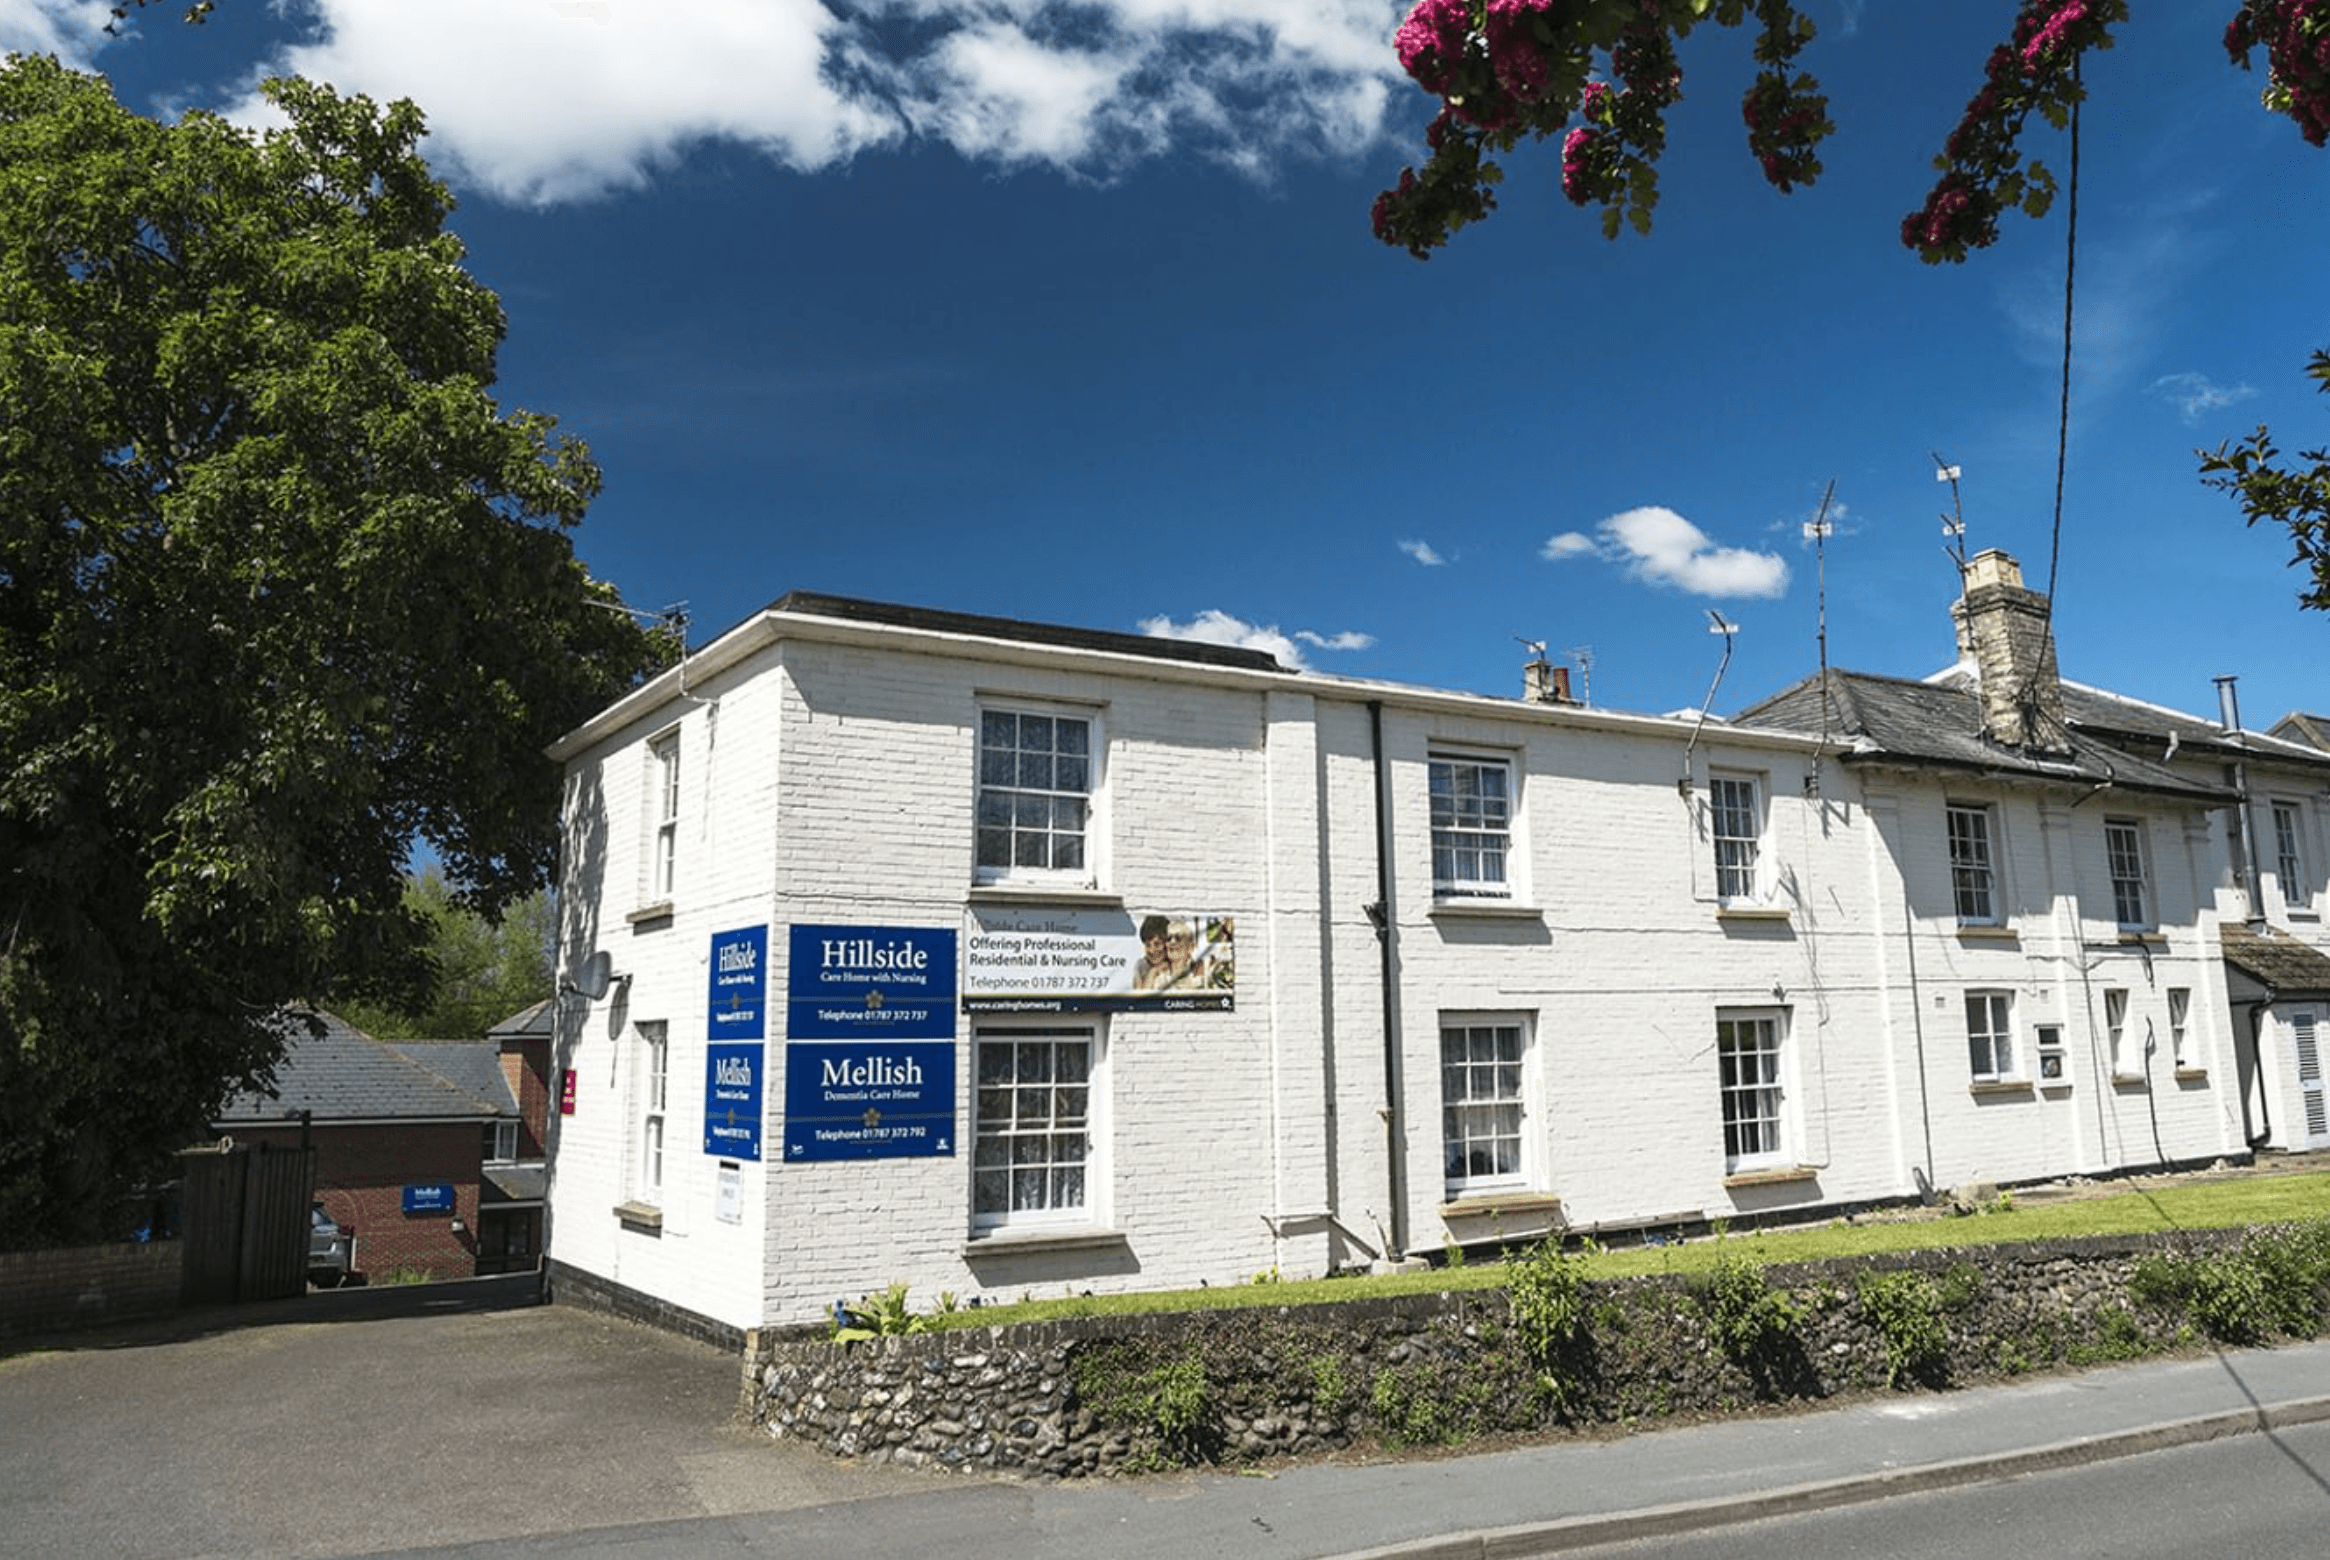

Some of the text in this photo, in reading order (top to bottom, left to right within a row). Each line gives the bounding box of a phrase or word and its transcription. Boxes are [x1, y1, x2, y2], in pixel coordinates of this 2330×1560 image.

[969, 937, 1096, 953] Offering Professional
[718, 940, 757, 973] Hillside
[821, 939, 928, 969] Hillside
[969, 953, 1126, 970] Residential & Nursing Care
[820, 970, 927, 986] Care Home with Nursing
[970, 976, 1109, 990] Telephone 01787 372 737
[818, 1009, 928, 1022] Telephone 01787 372 737
[715, 1057, 752, 1086] Mellish
[820, 1056, 924, 1087] Mellish
[824, 1089, 920, 1101] Dementia Care Home
[815, 1126, 926, 1141] Telephone 01787 372 792
